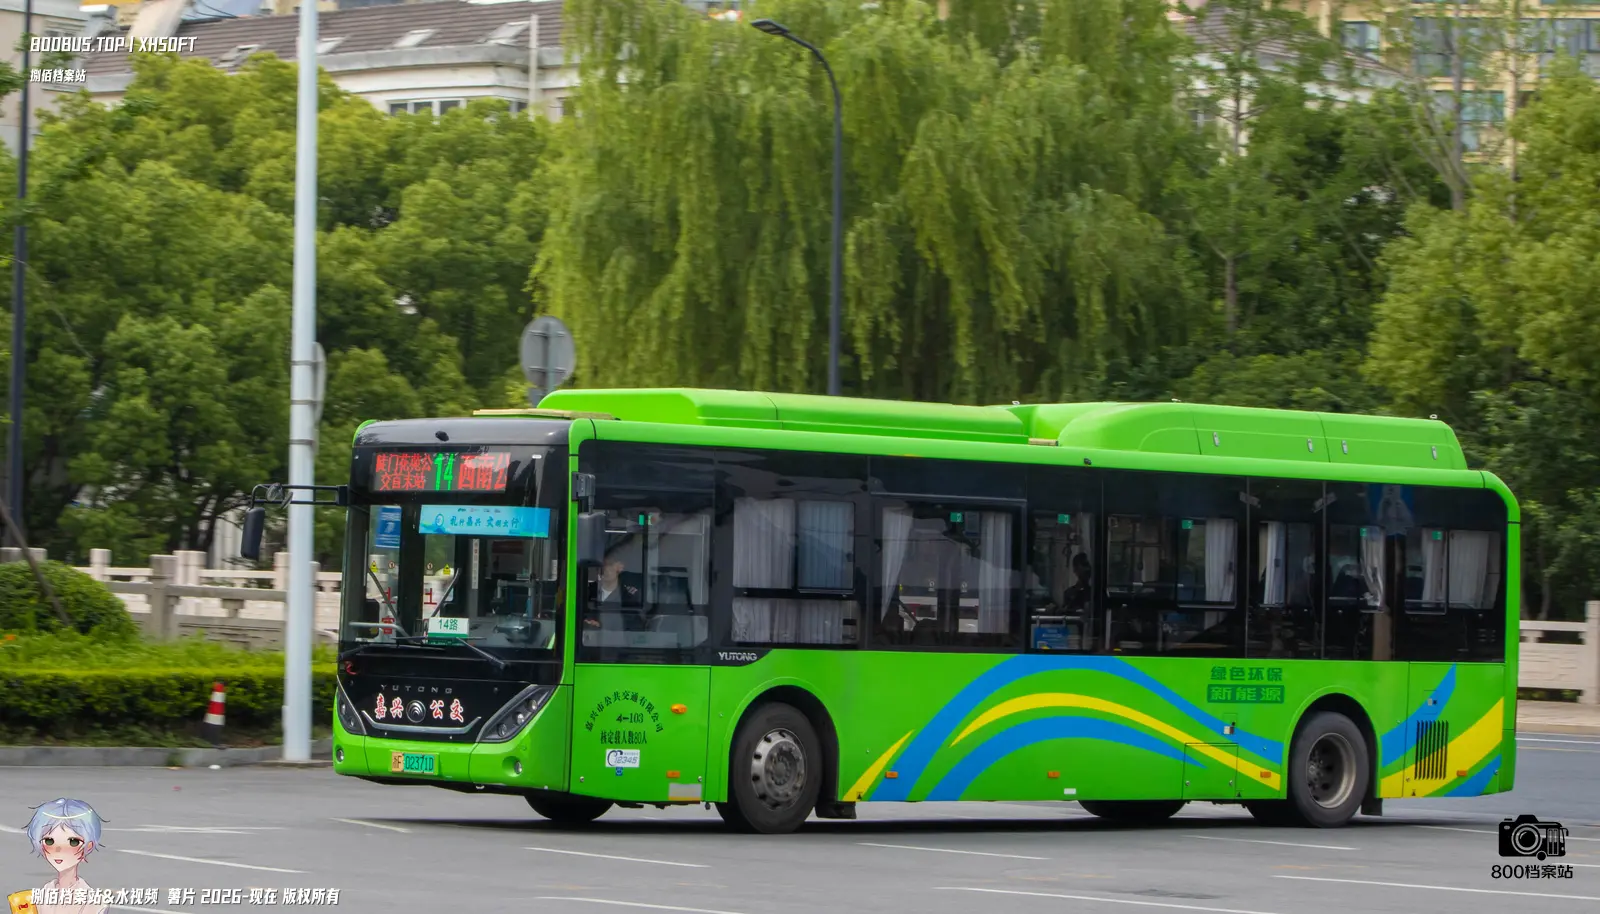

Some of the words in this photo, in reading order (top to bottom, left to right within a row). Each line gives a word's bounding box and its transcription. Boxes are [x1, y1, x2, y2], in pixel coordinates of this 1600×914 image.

[434, 453, 456, 491] 14
[438, 618, 459, 631] 14路
[717, 651, 758, 662] YUTONG
[1210, 666, 1283, 682] 绿色环保
[380, 684, 453, 695] YUTONG
[1210, 686, 1282, 701] 新能源
[375, 693, 404, 719] 嘉兴
[429, 698, 465, 723] 公交
[585, 690, 664, 733] 嘉兴市公共交通有限公司
[615, 713, 644, 723] 4-103
[613, 756, 638, 764] 12345
